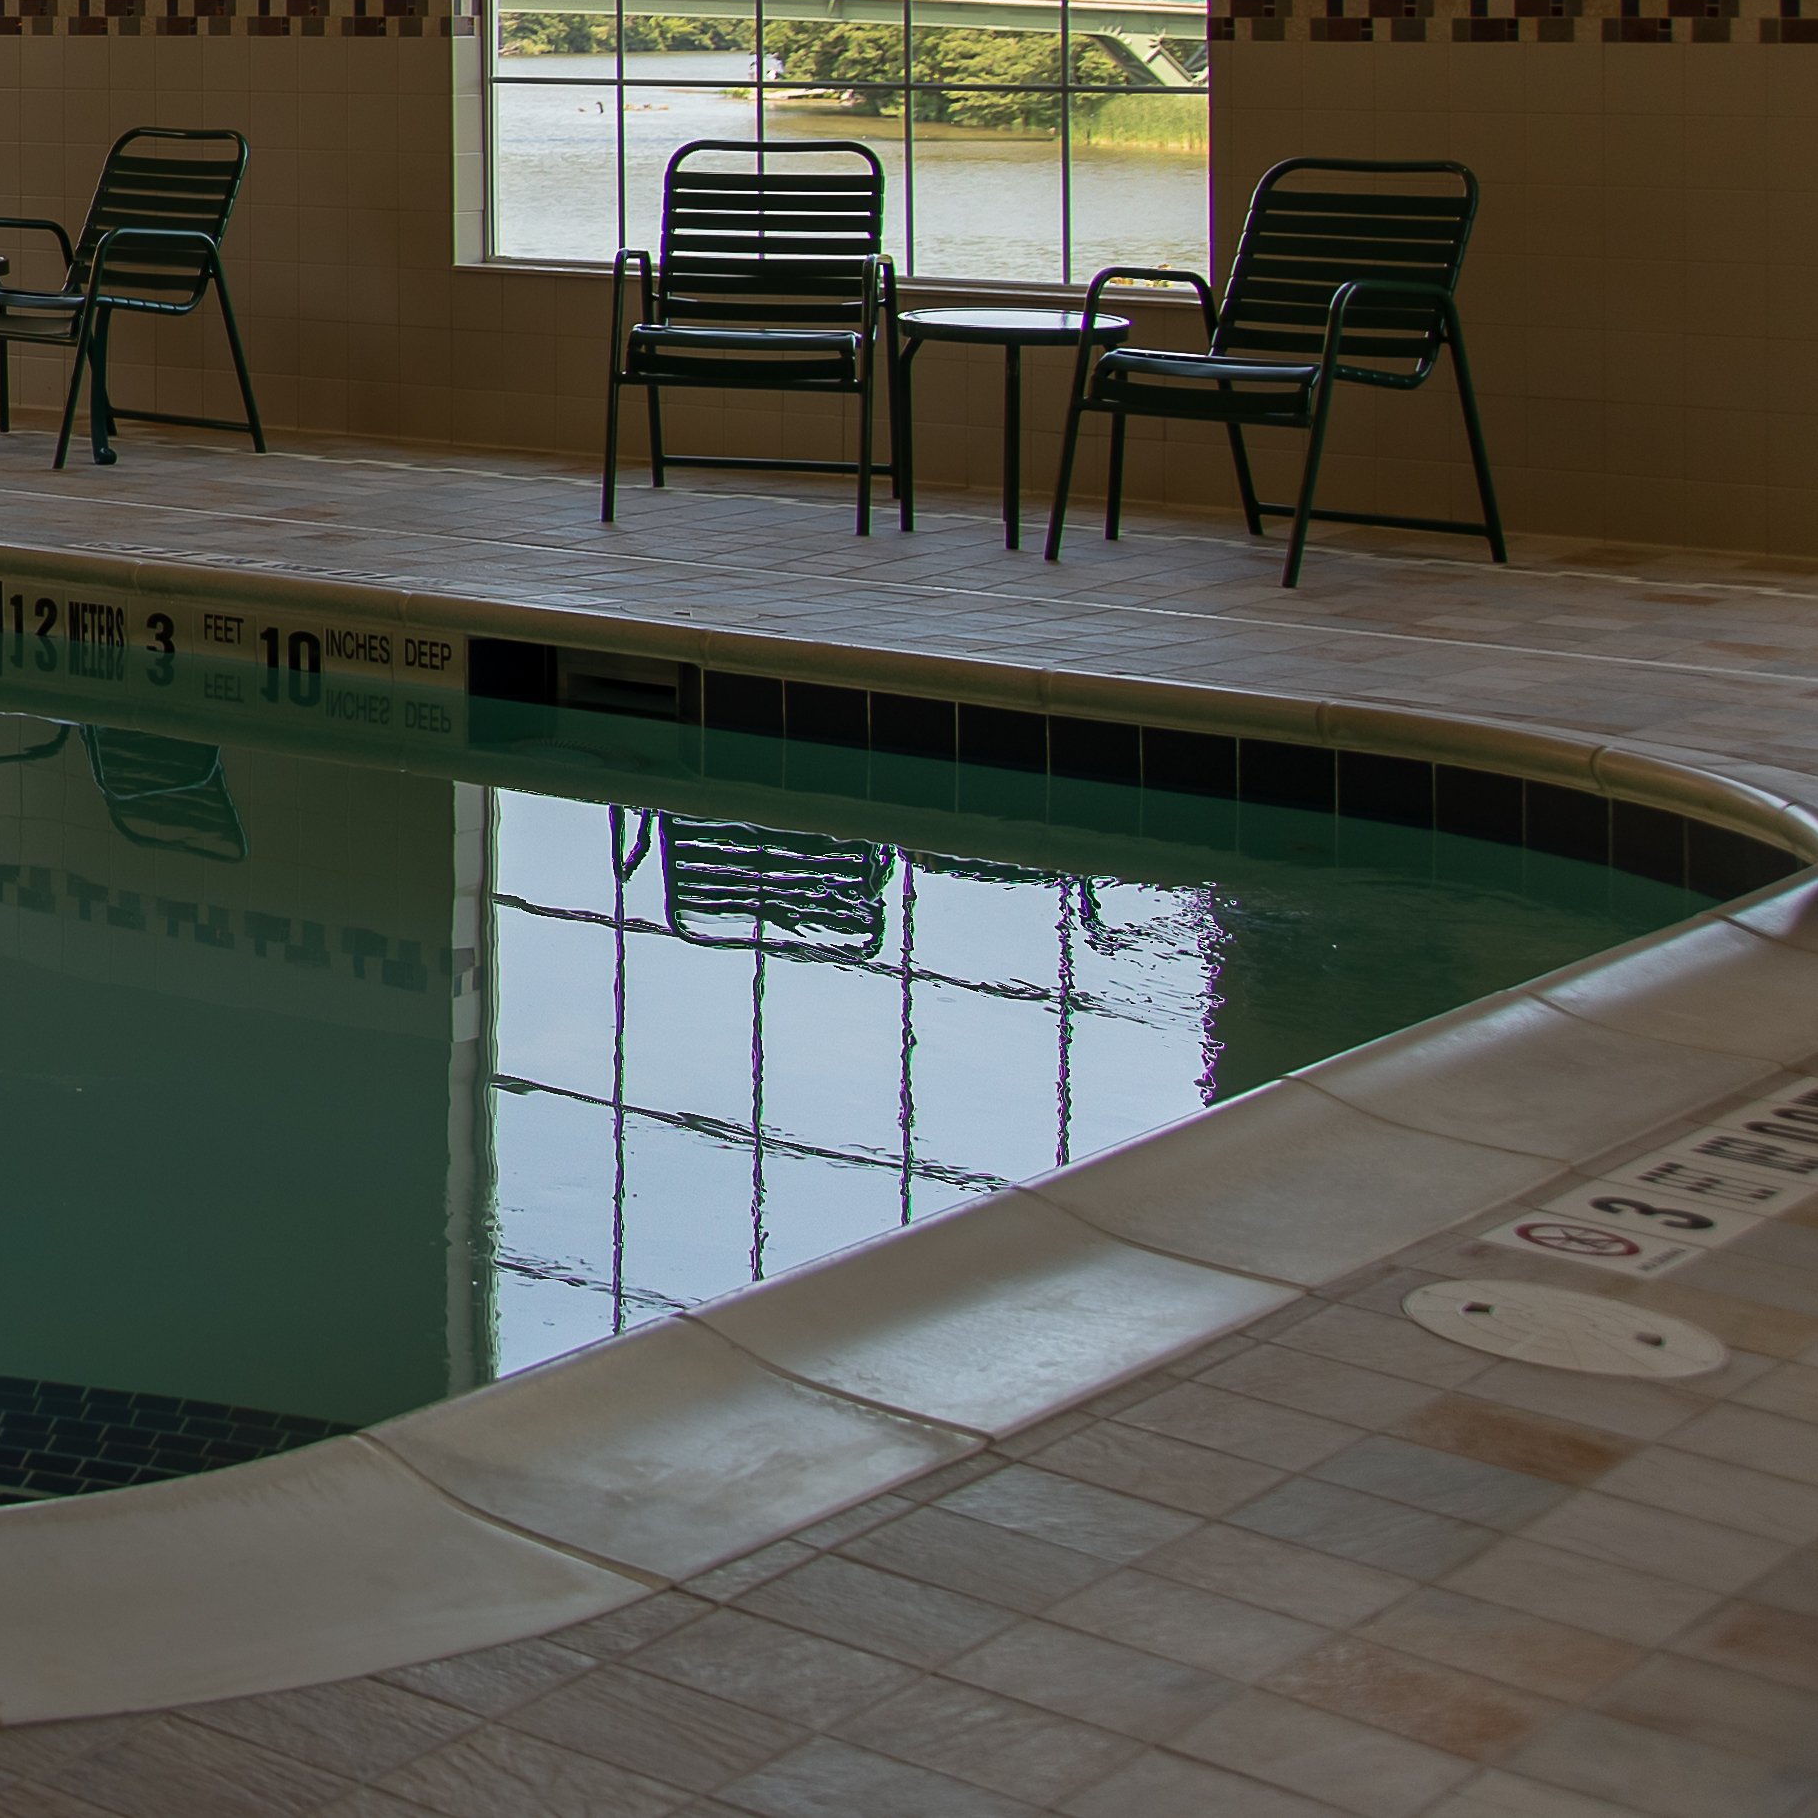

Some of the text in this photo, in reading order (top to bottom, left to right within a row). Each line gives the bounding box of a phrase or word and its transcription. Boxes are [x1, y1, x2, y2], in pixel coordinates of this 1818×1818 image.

[68, 600, 125, 647] METERS
[146, 612, 176, 654] 3
[203, 613, 244, 645] FEET
[259, 626, 321, 673] 10
[325, 628, 390, 665] INCHES
[404, 638, 452, 671] DEEP
[1588, 1195, 1715, 1230] 3
